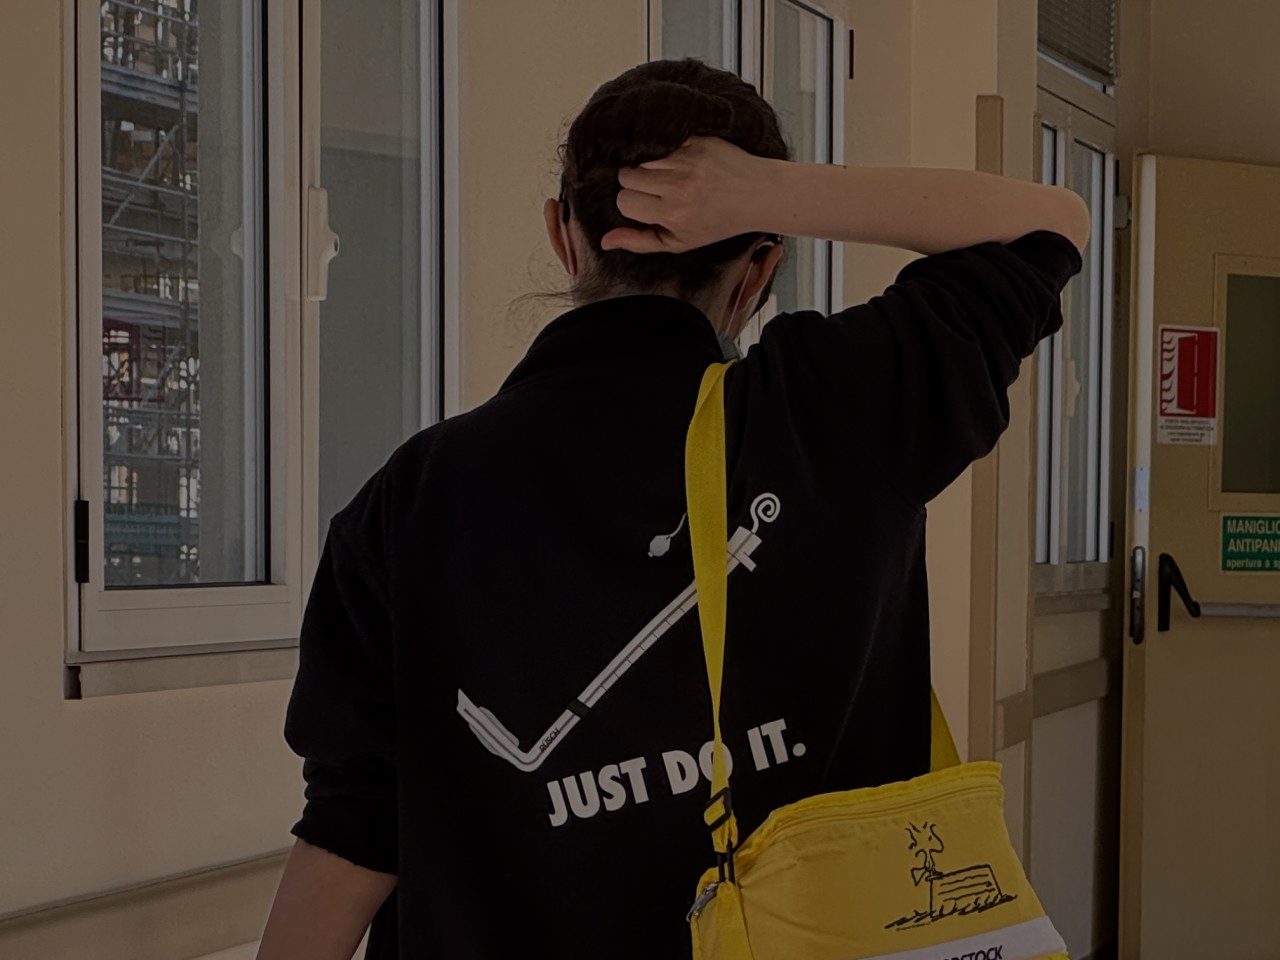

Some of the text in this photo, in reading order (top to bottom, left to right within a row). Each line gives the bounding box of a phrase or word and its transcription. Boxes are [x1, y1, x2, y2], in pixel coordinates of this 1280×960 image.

[546, 717, 807, 828] JUST DO IT.
